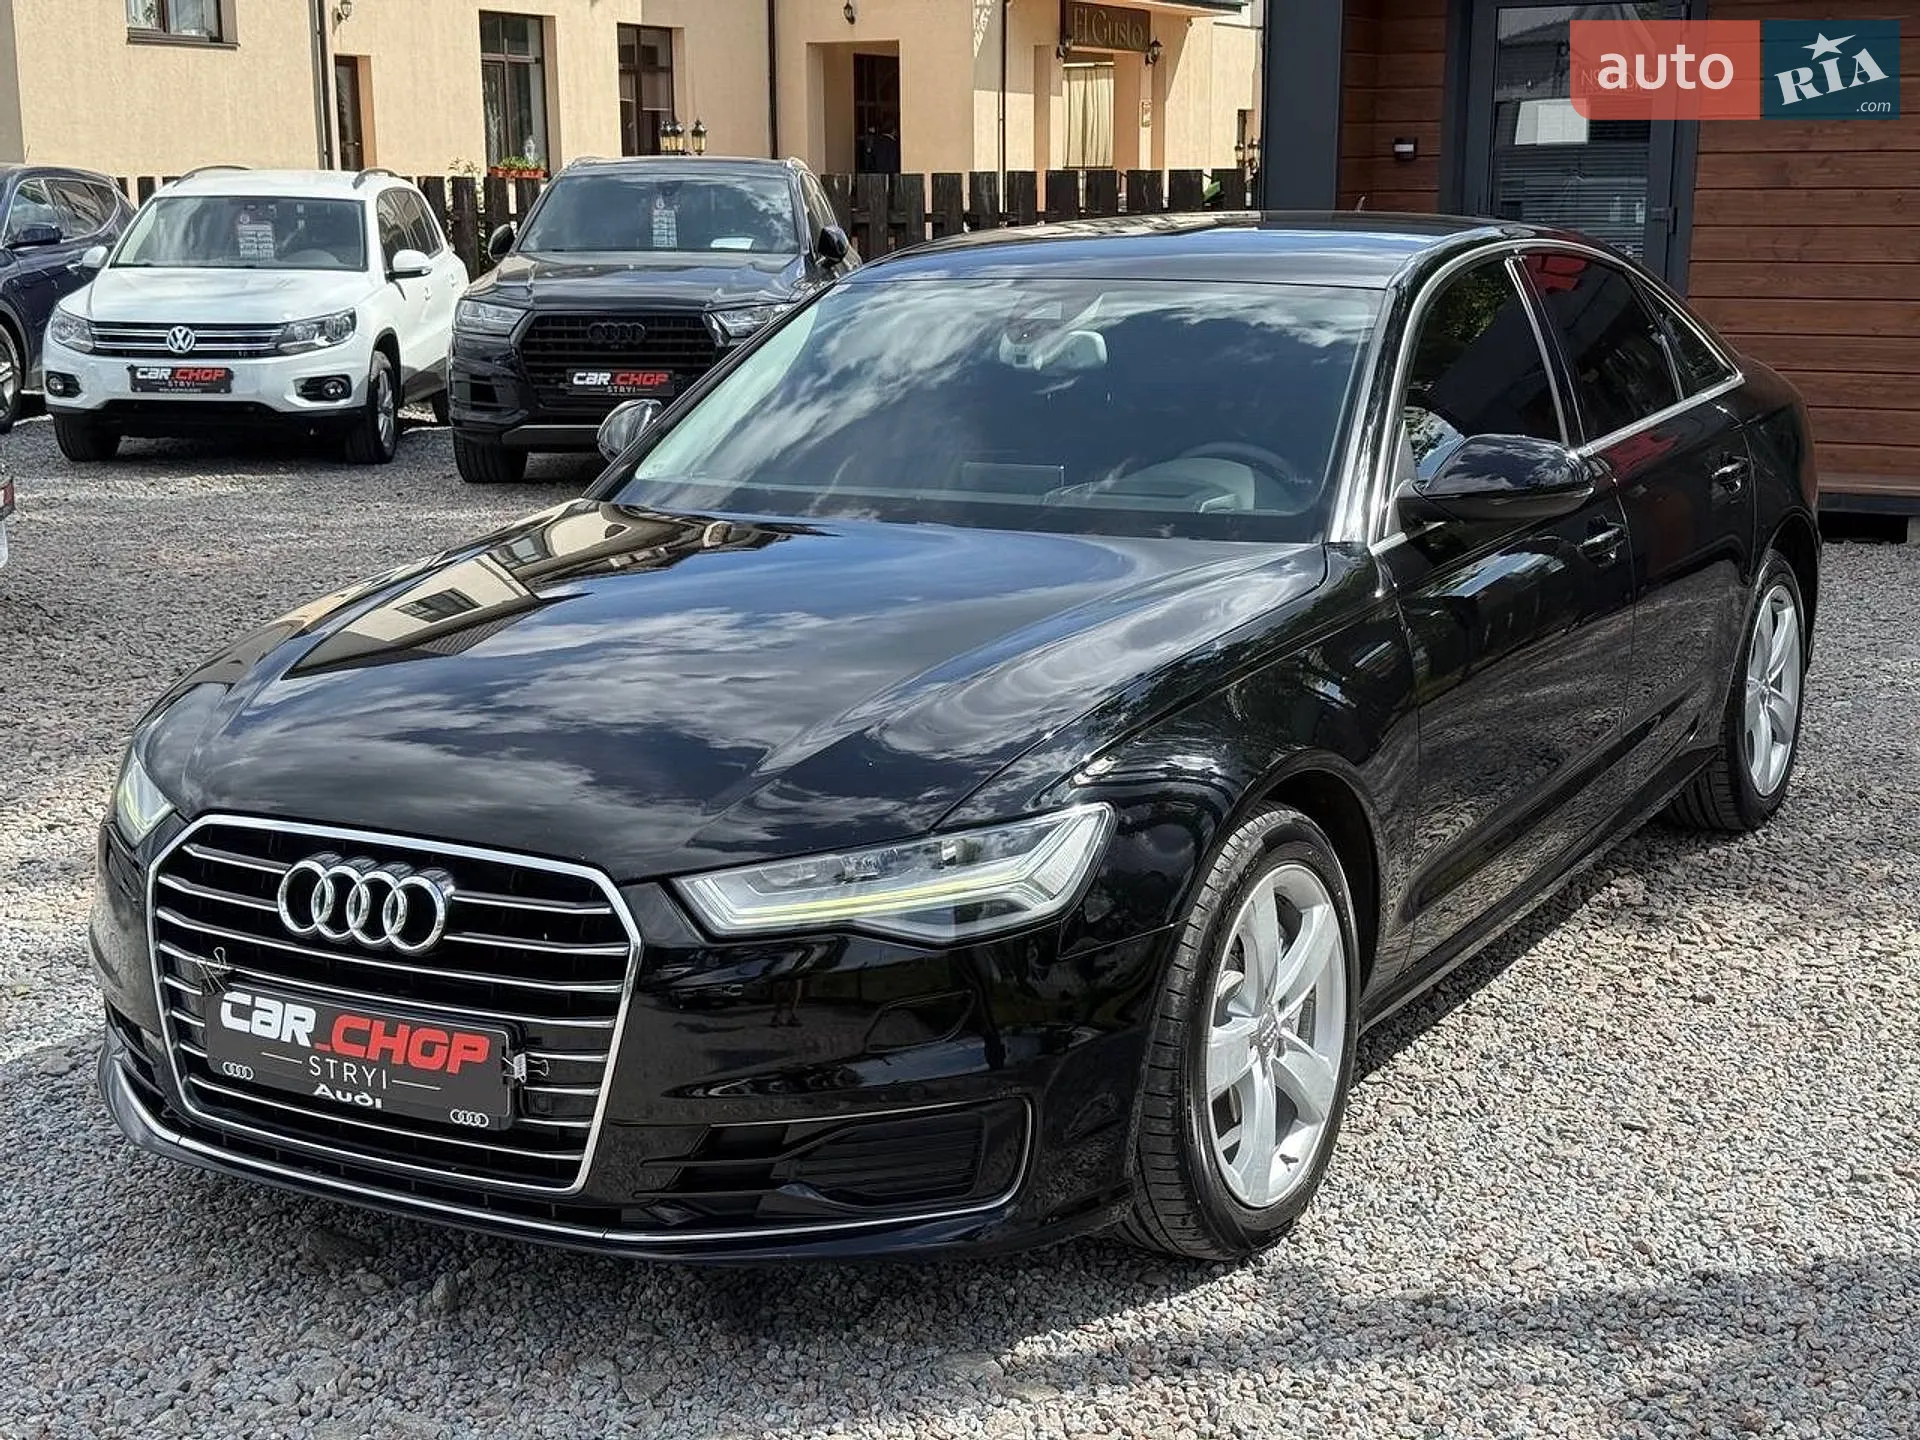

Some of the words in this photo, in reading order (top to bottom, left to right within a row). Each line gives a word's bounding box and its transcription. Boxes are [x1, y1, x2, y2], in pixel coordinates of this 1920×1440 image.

[1092, 9, 1144, 48] Gusto
[308, 1056, 388, 1090] STRYI
[313, 1083, 384, 1110] Audi
